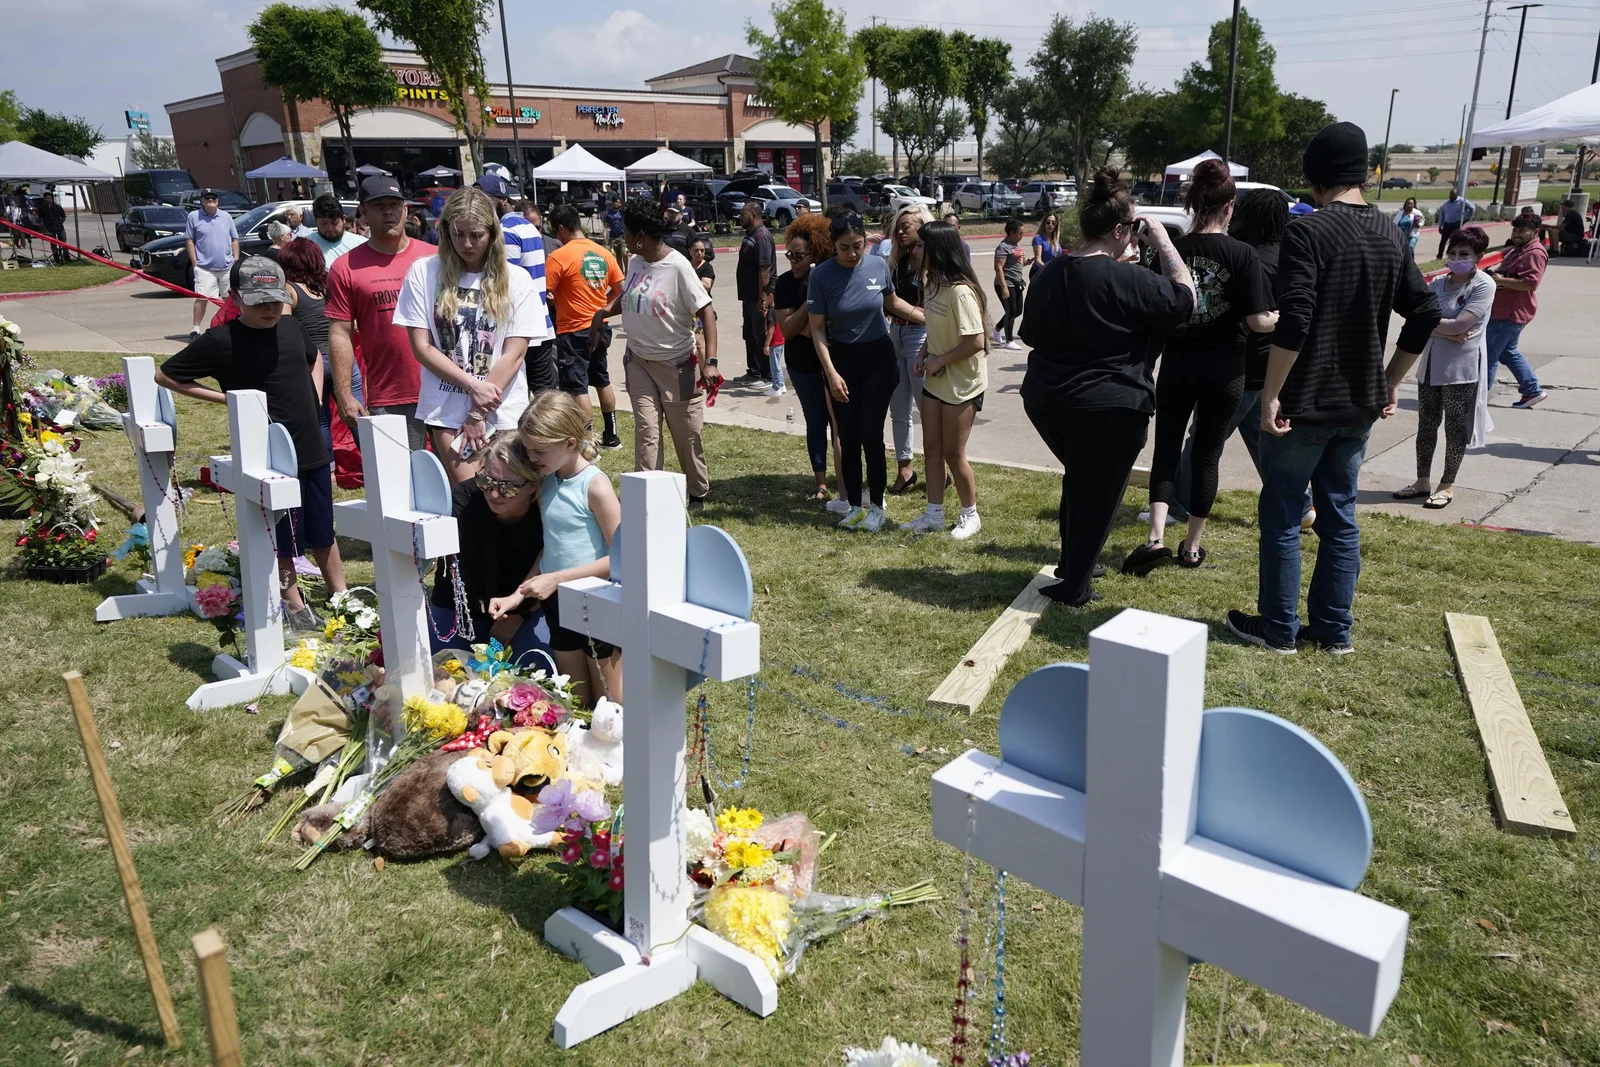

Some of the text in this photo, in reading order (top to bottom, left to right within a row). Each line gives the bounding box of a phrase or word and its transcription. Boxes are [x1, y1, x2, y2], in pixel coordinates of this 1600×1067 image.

[398, 88, 449, 100] PINTS
[489, 106, 541, 120] Hazl Sky
[577, 105, 619, 114] PERFECT TEN
[611, 113, 625, 127] Spa
